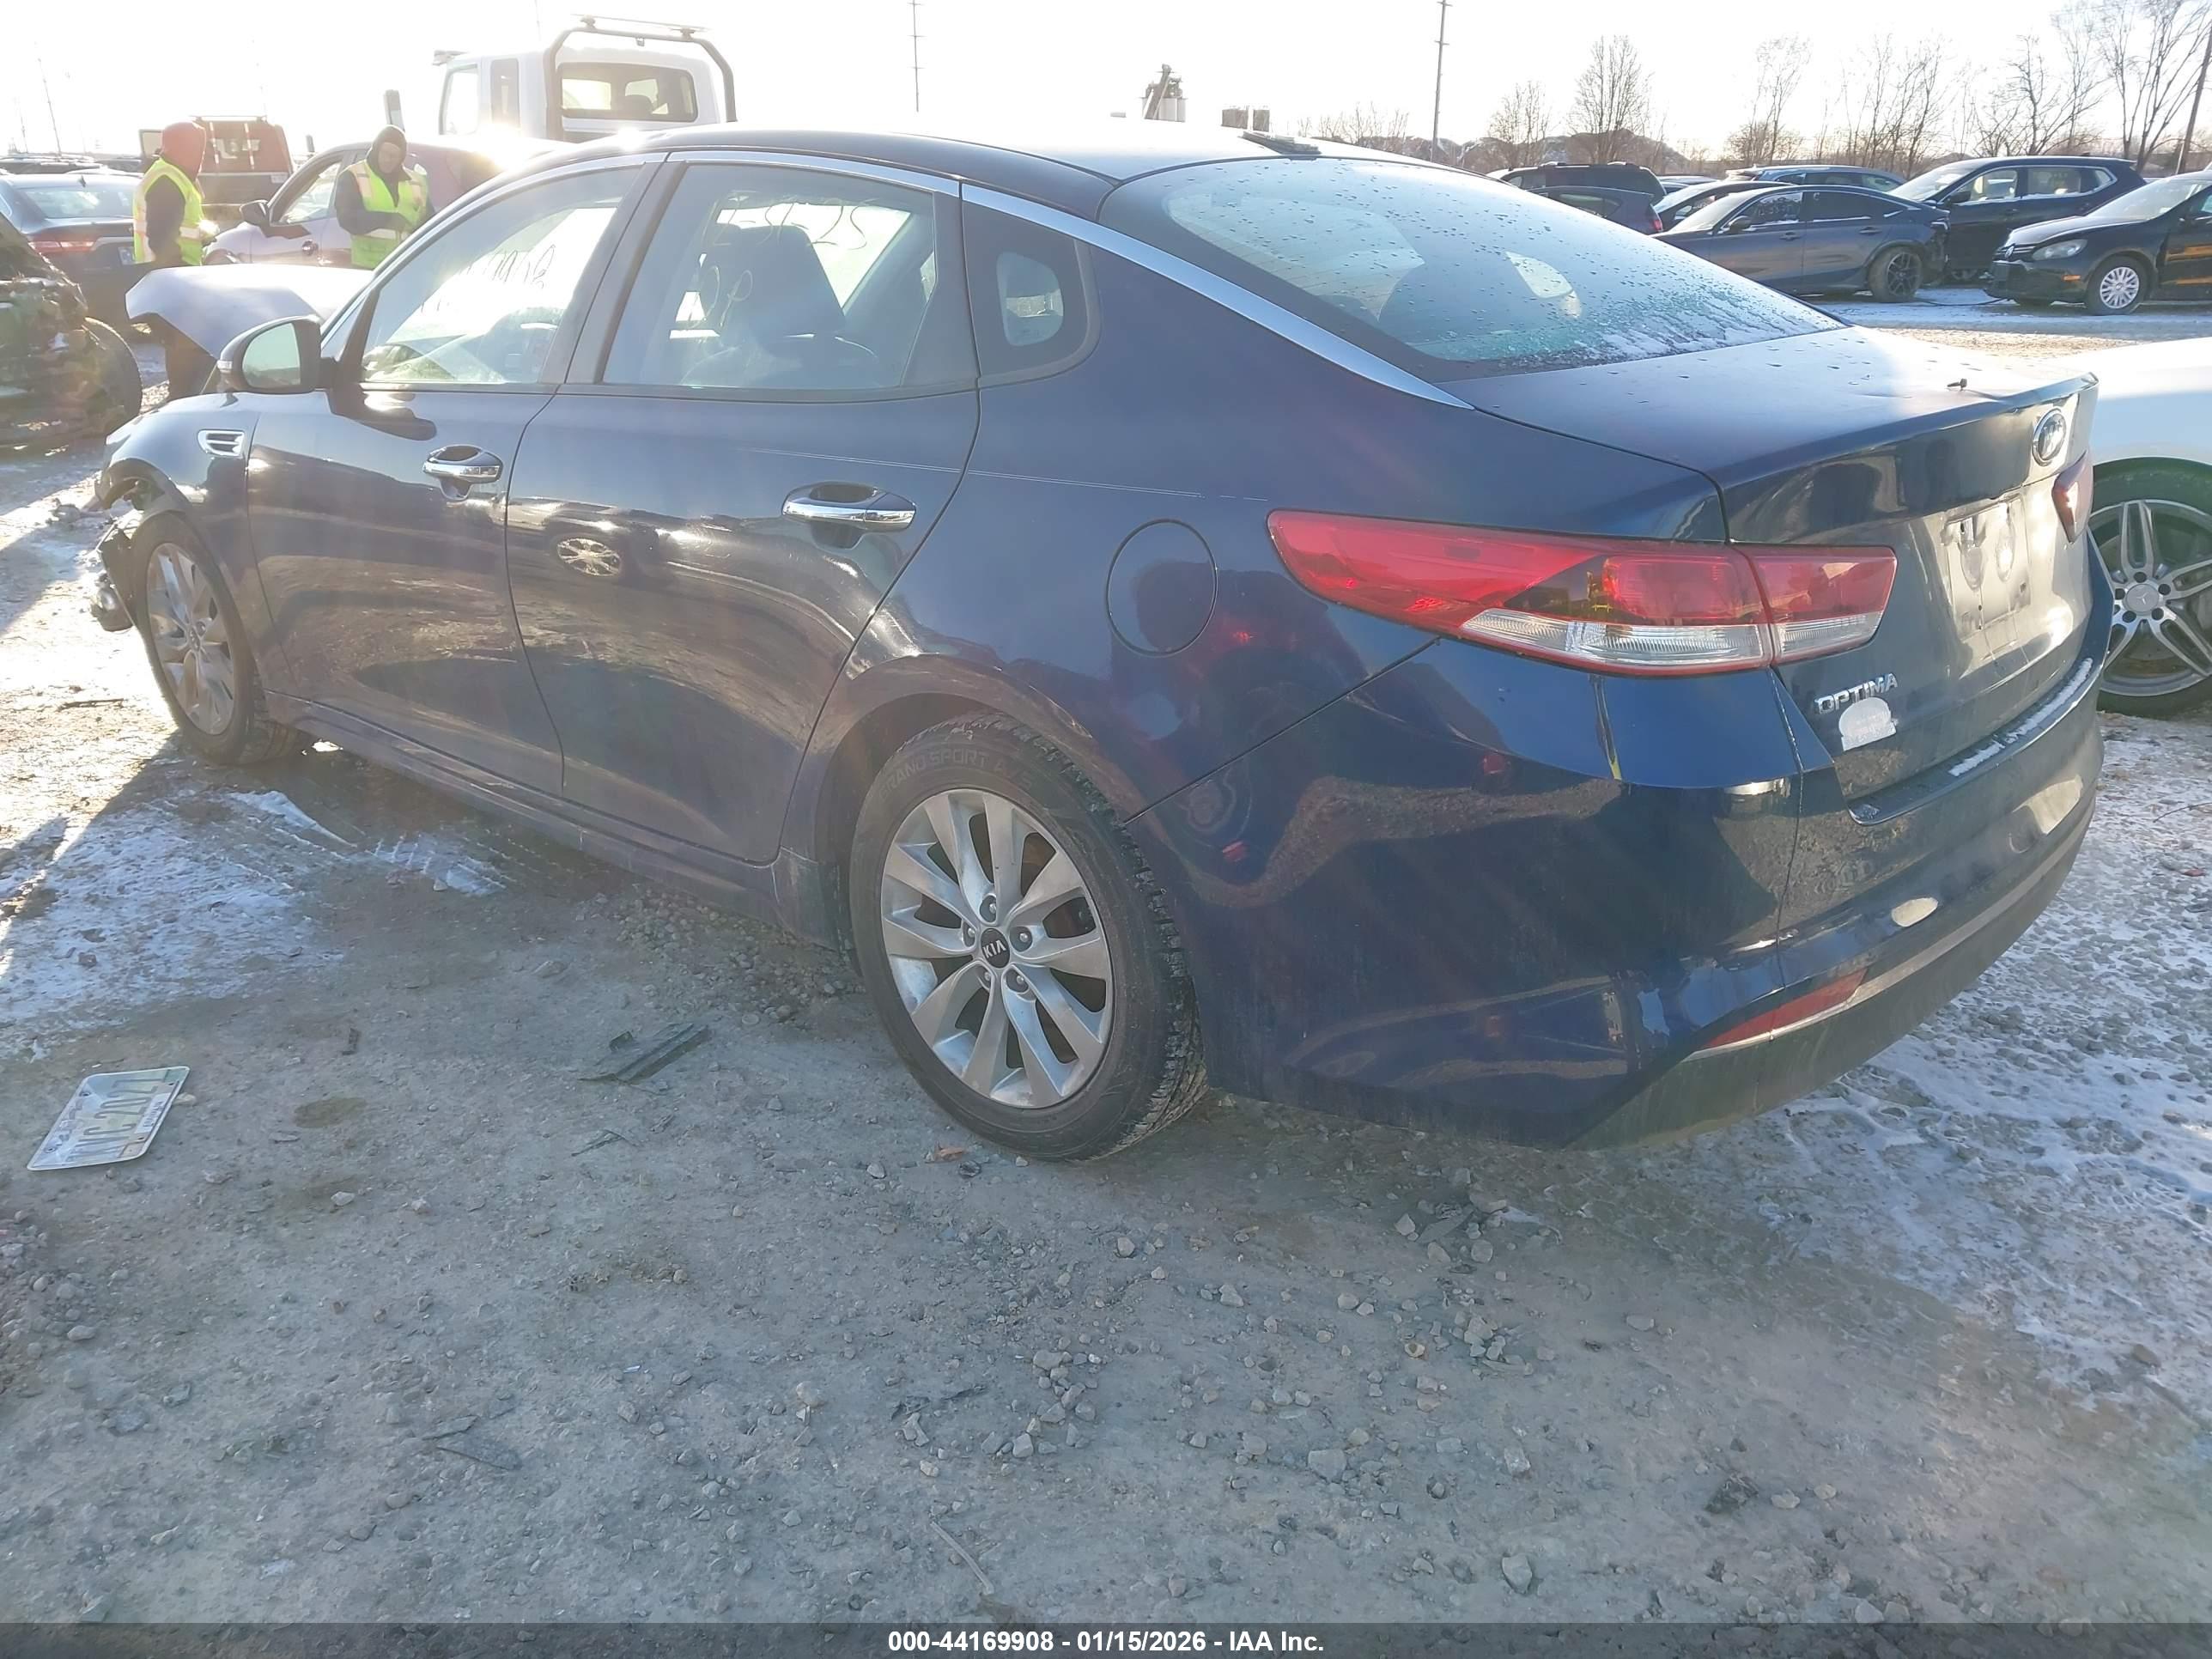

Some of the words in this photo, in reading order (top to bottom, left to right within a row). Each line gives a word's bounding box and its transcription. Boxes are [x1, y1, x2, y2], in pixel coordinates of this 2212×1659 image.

[1814, 672, 1899, 715] OPTIMA
[930, 747, 990, 766] SPORT
[982, 939, 1007, 959] KIA
